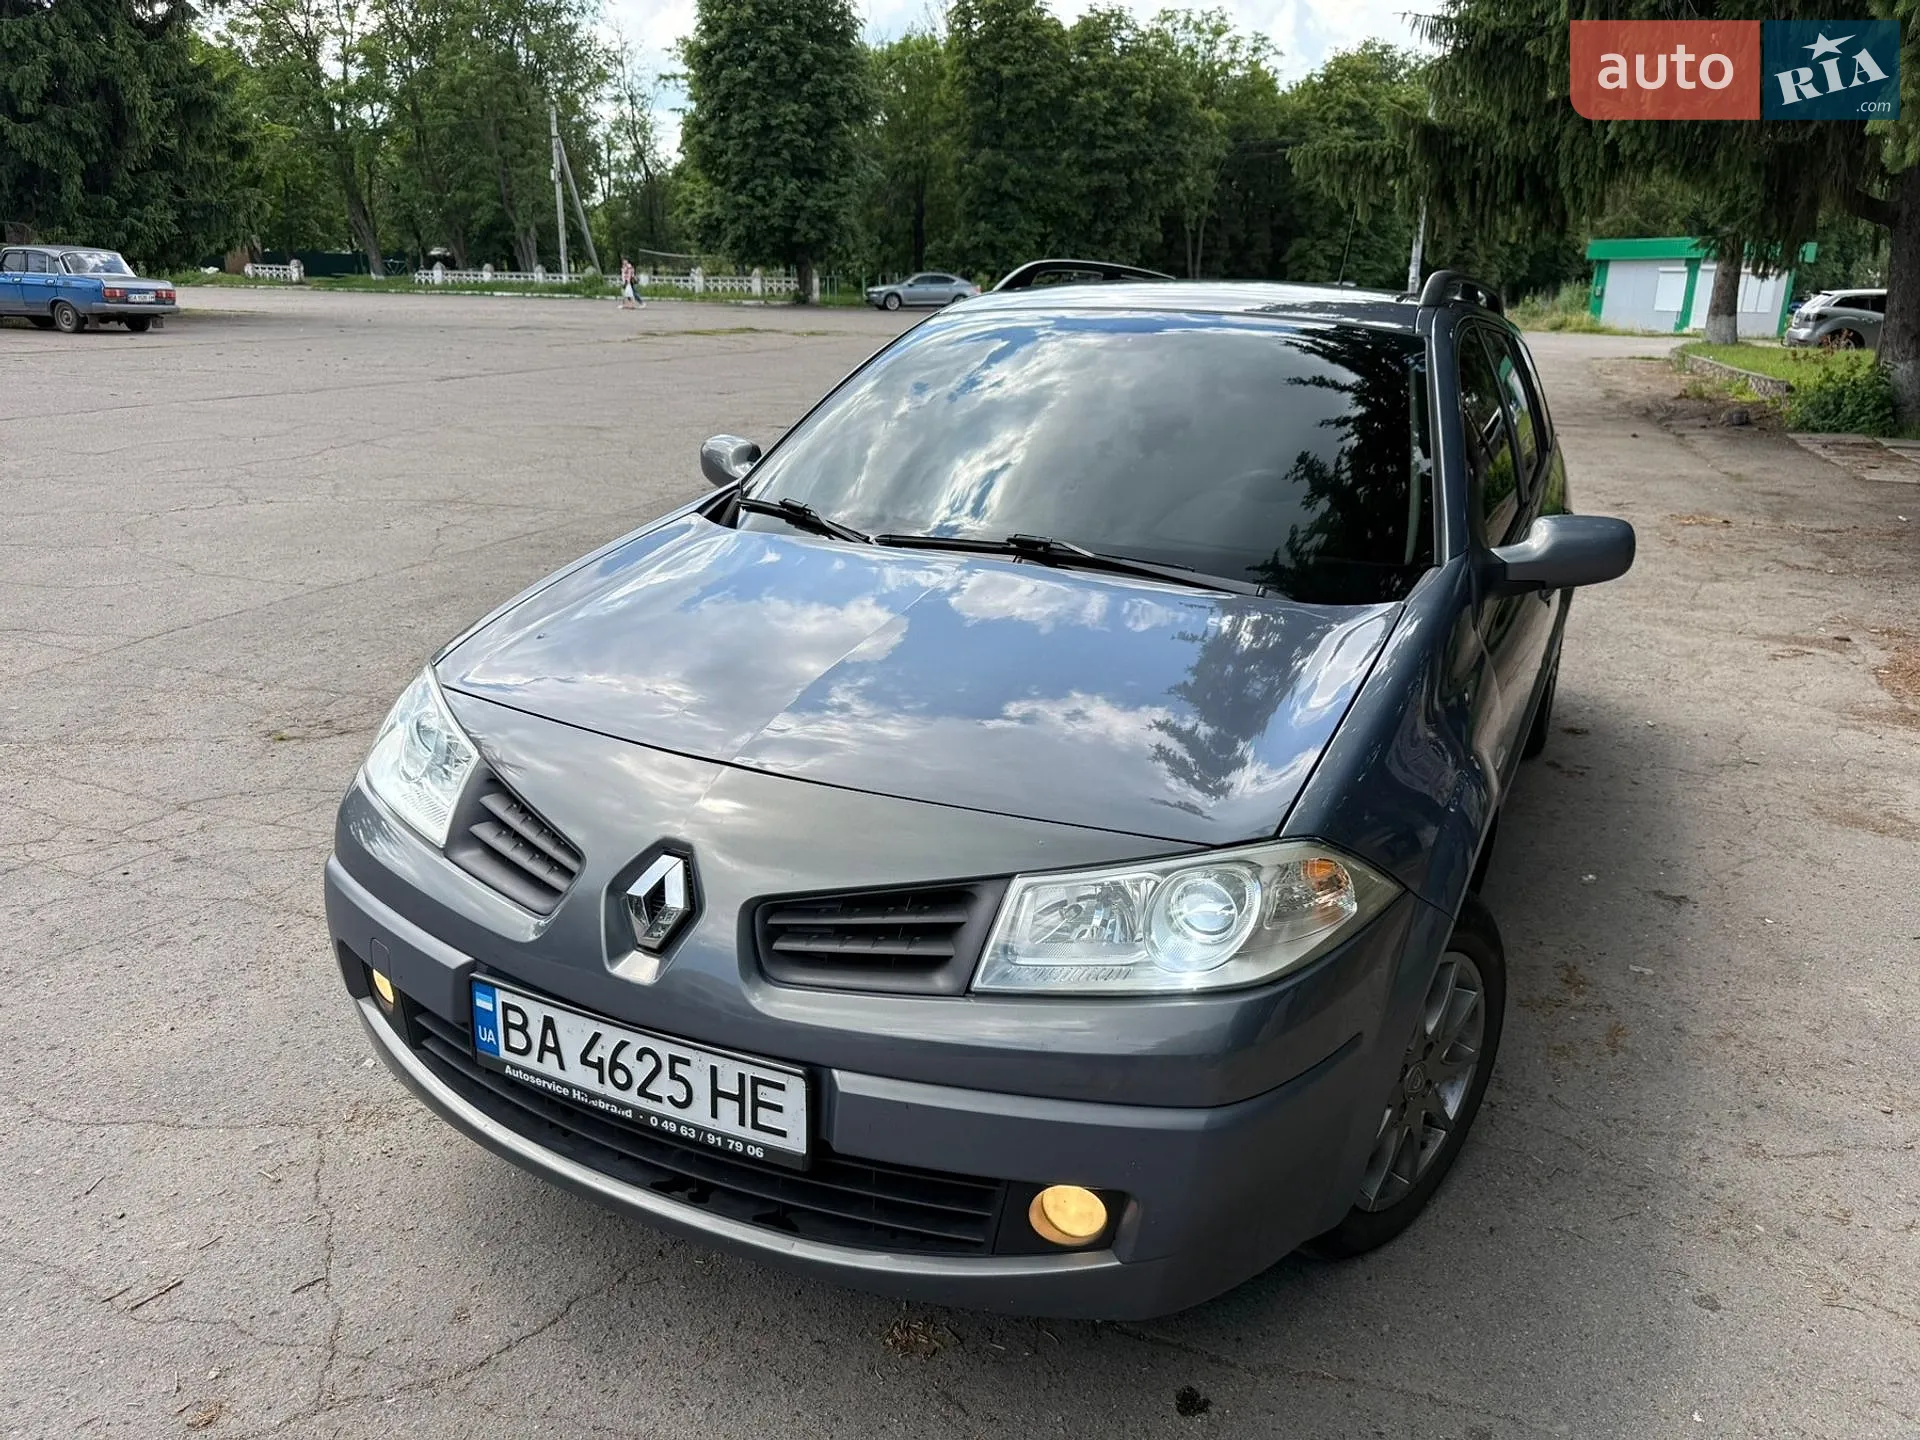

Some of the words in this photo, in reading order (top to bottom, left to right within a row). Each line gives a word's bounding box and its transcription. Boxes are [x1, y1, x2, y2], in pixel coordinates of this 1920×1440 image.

[478, 1024, 497, 1046] UA
[501, 1000, 566, 1071] BA
[579, 1031, 694, 1109] 4625
[709, 1064, 788, 1138] HE
[505, 1064, 570, 1096] Autoservice
[649, 1116, 659, 1127] 0
[661, 1120, 677, 1132] 49
[679, 1125, 696, 1139] 63
[698, 1131, 704, 1142] /
[706, 1133, 722, 1146] 91
[726, 1139, 744, 1152] 79
[746, 1144, 765, 1158] 06
